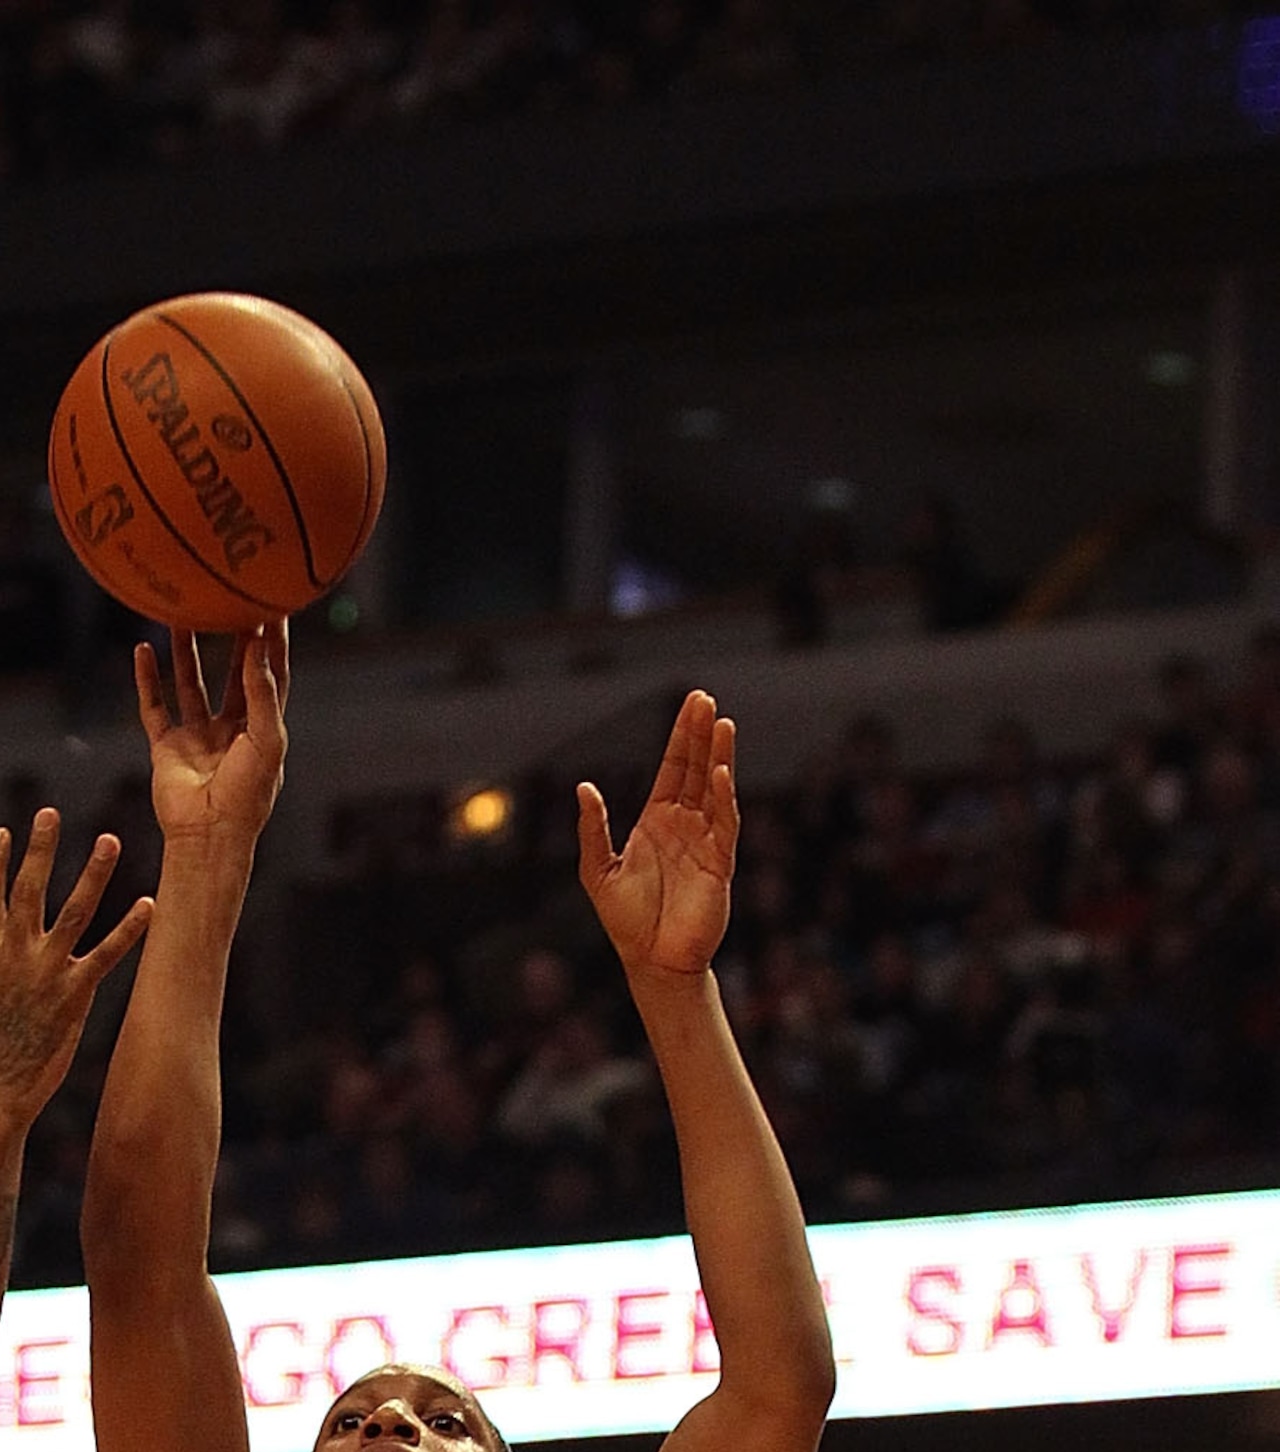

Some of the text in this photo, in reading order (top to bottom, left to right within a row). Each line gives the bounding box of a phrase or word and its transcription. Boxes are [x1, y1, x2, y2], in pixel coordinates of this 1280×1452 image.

[122, 351, 277, 572] SPALDING
[242, 1315, 396, 1408] GO
[904, 1241, 1235, 1357] SAVE
